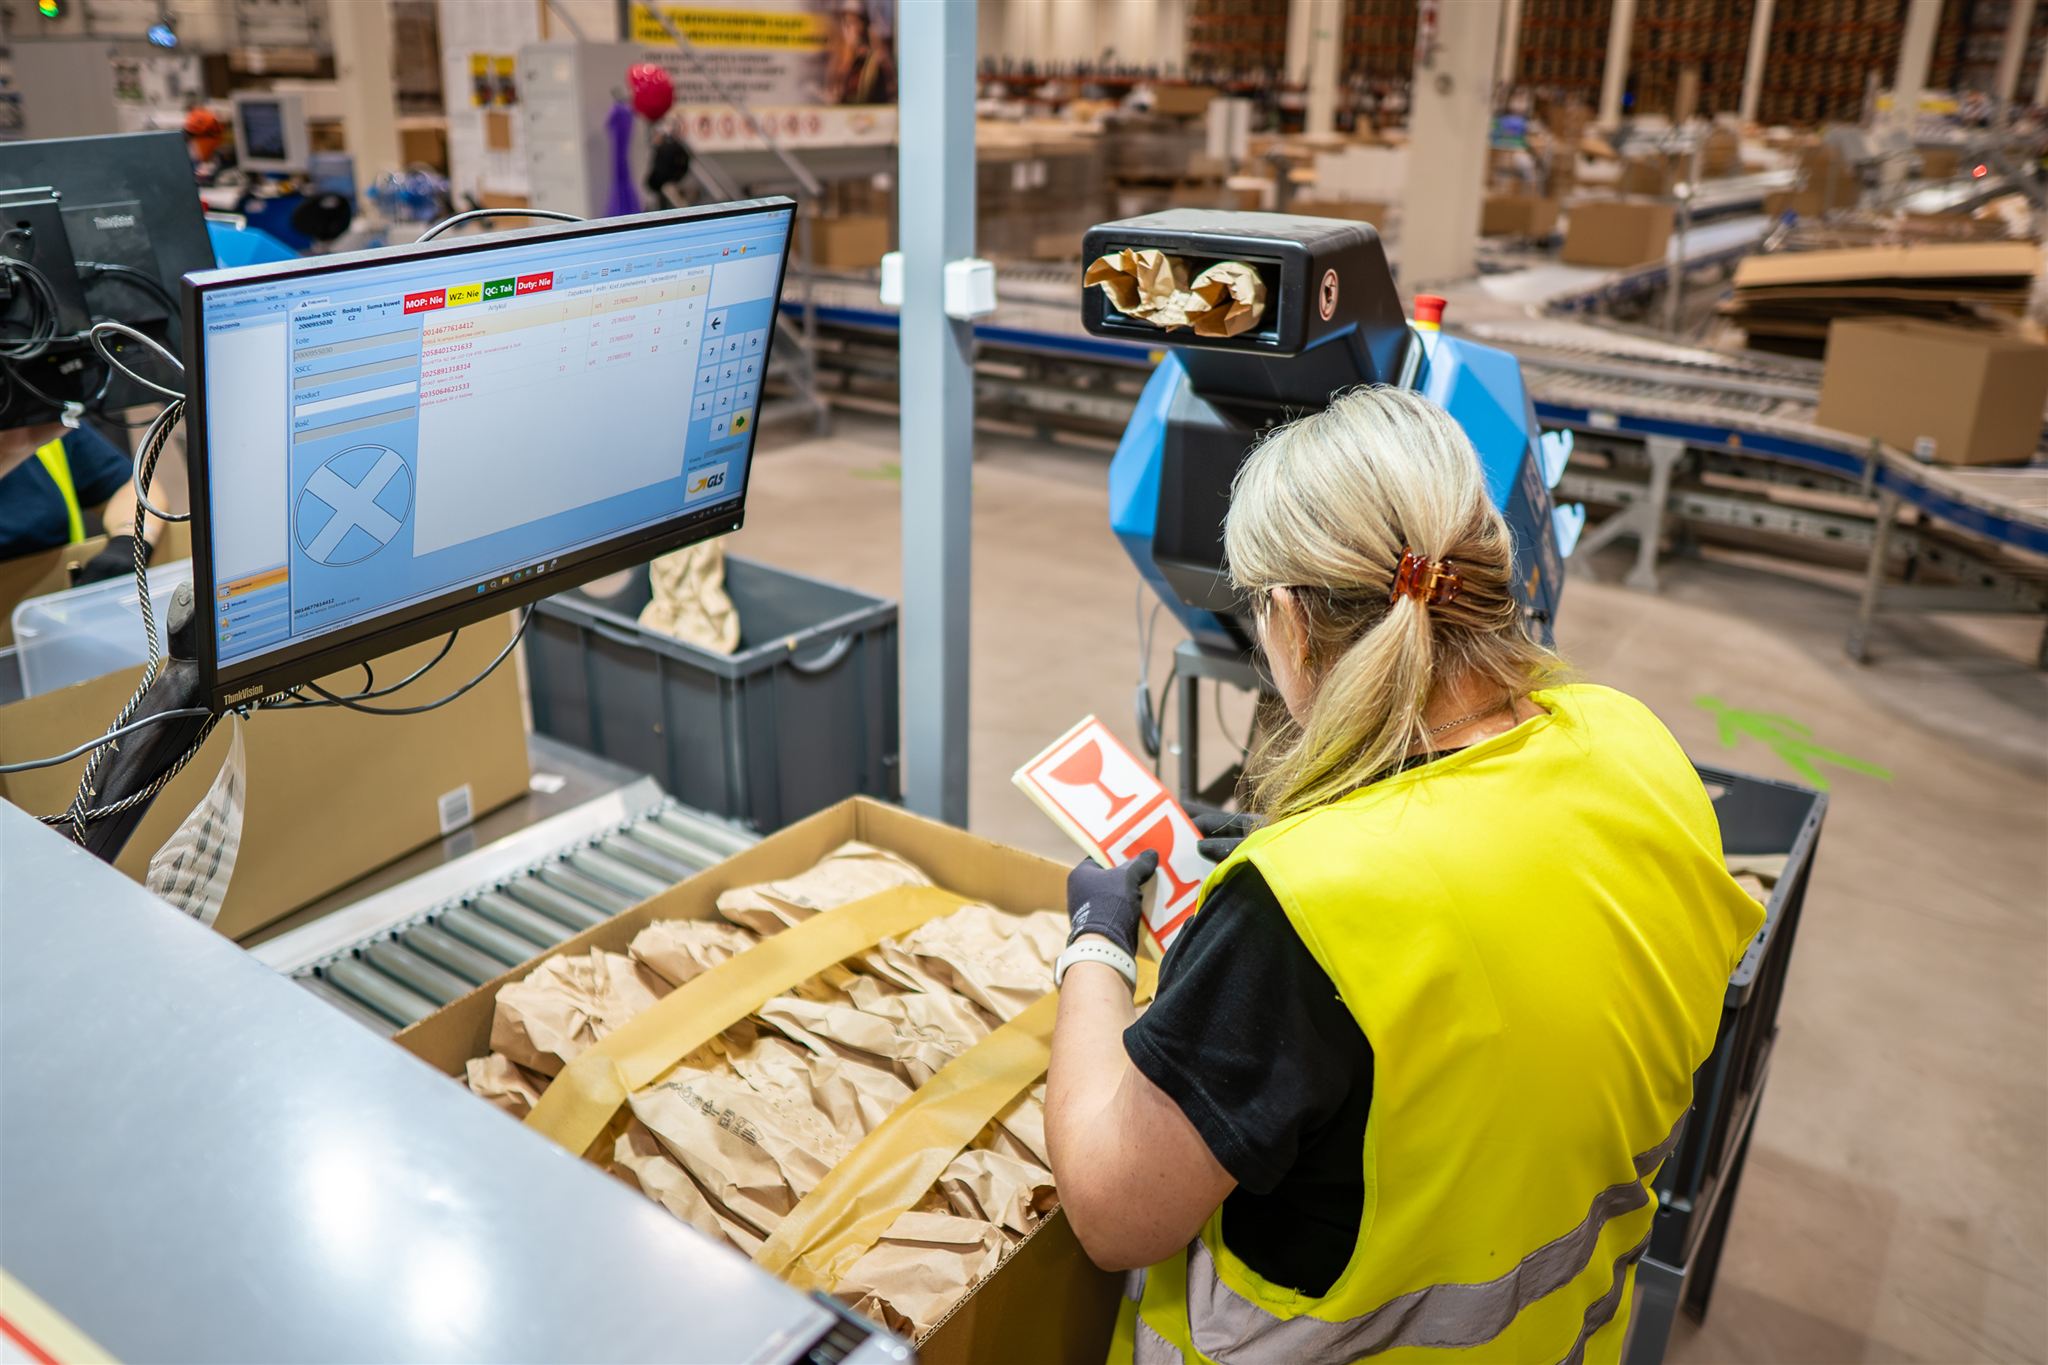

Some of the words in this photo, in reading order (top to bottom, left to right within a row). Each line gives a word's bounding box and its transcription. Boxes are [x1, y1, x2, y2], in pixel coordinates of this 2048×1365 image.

[518, 280, 537, 292] Duty:
[539, 278, 551, 287] Nie
[485, 287, 498, 296] QC:
[500, 284, 513, 293] Tak
[449, 292, 464, 301] WZ:
[466, 290, 479, 298] Nie
[366, 302, 382, 310] Suma
[383, 299, 400, 307] kuwet
[405, 297, 428, 309] MOP:
[429, 295, 443, 305] Nie
[342, 305, 361, 315] Rodzaj
[294, 312, 320, 322] Aktualne
[322, 309, 336, 317] SSCC
[730, 342, 735, 351] 8
[751, 338, 756, 346] 9
[708, 347, 714, 356] 7
[295, 364, 311, 373] SSCC
[747, 365, 752, 373] 6
[725, 370, 730, 378] 5
[704, 375, 710, 383] 4
[294, 389, 319, 402] Product
[743, 391, 747, 399] 3
[721, 397, 726, 405] 2
[717, 423, 722, 431] 0
[707, 471, 724, 488] GLS
[223, 684, 264, 705] ThinkVision
